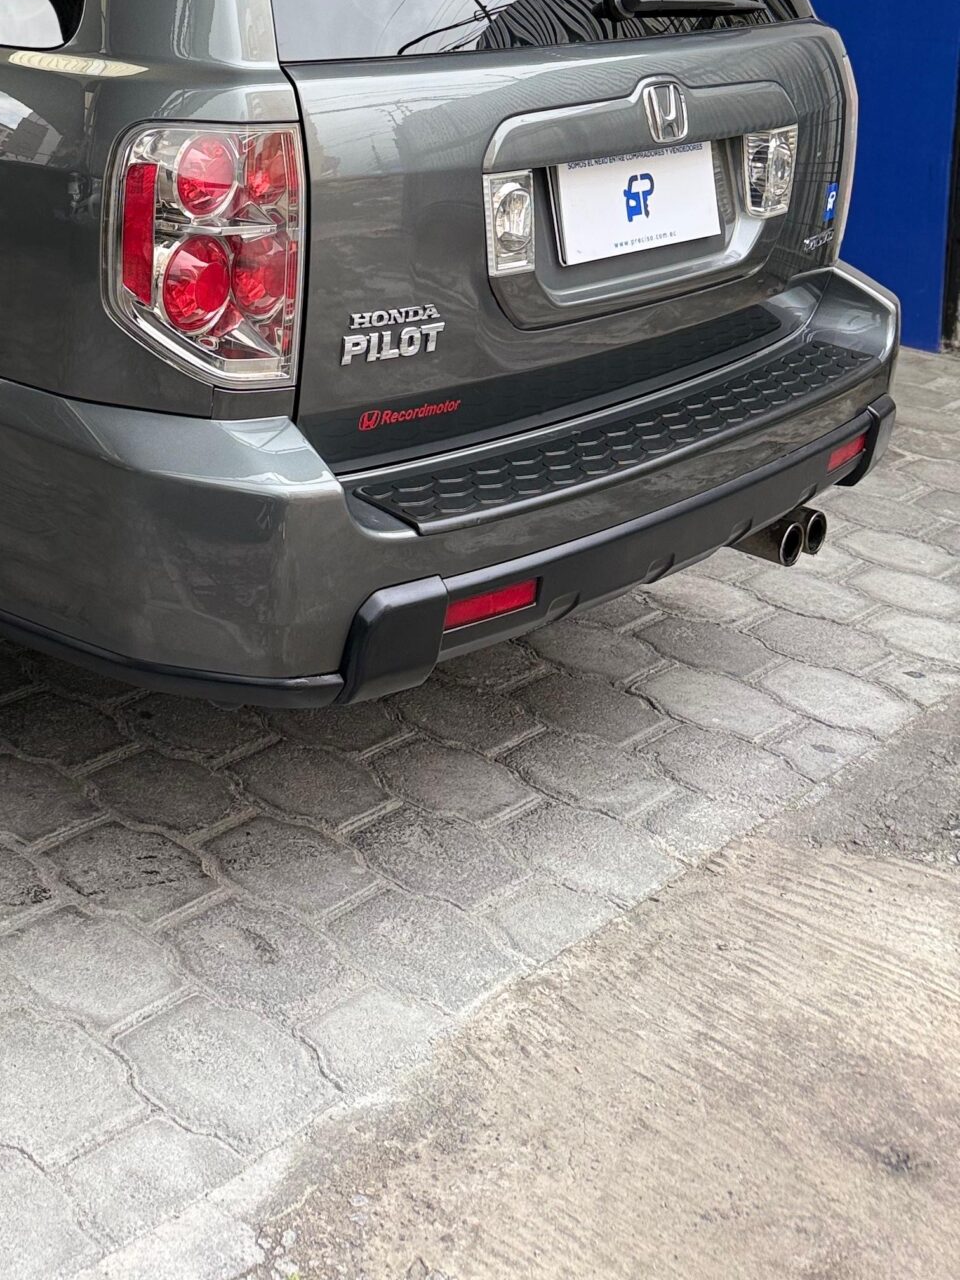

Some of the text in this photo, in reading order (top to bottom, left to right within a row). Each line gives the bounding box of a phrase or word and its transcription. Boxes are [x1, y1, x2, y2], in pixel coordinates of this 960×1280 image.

[350, 304, 440, 329] HONDA
[341, 322, 445, 365] PILOT
[382, 400, 461, 424] Recordmotor
